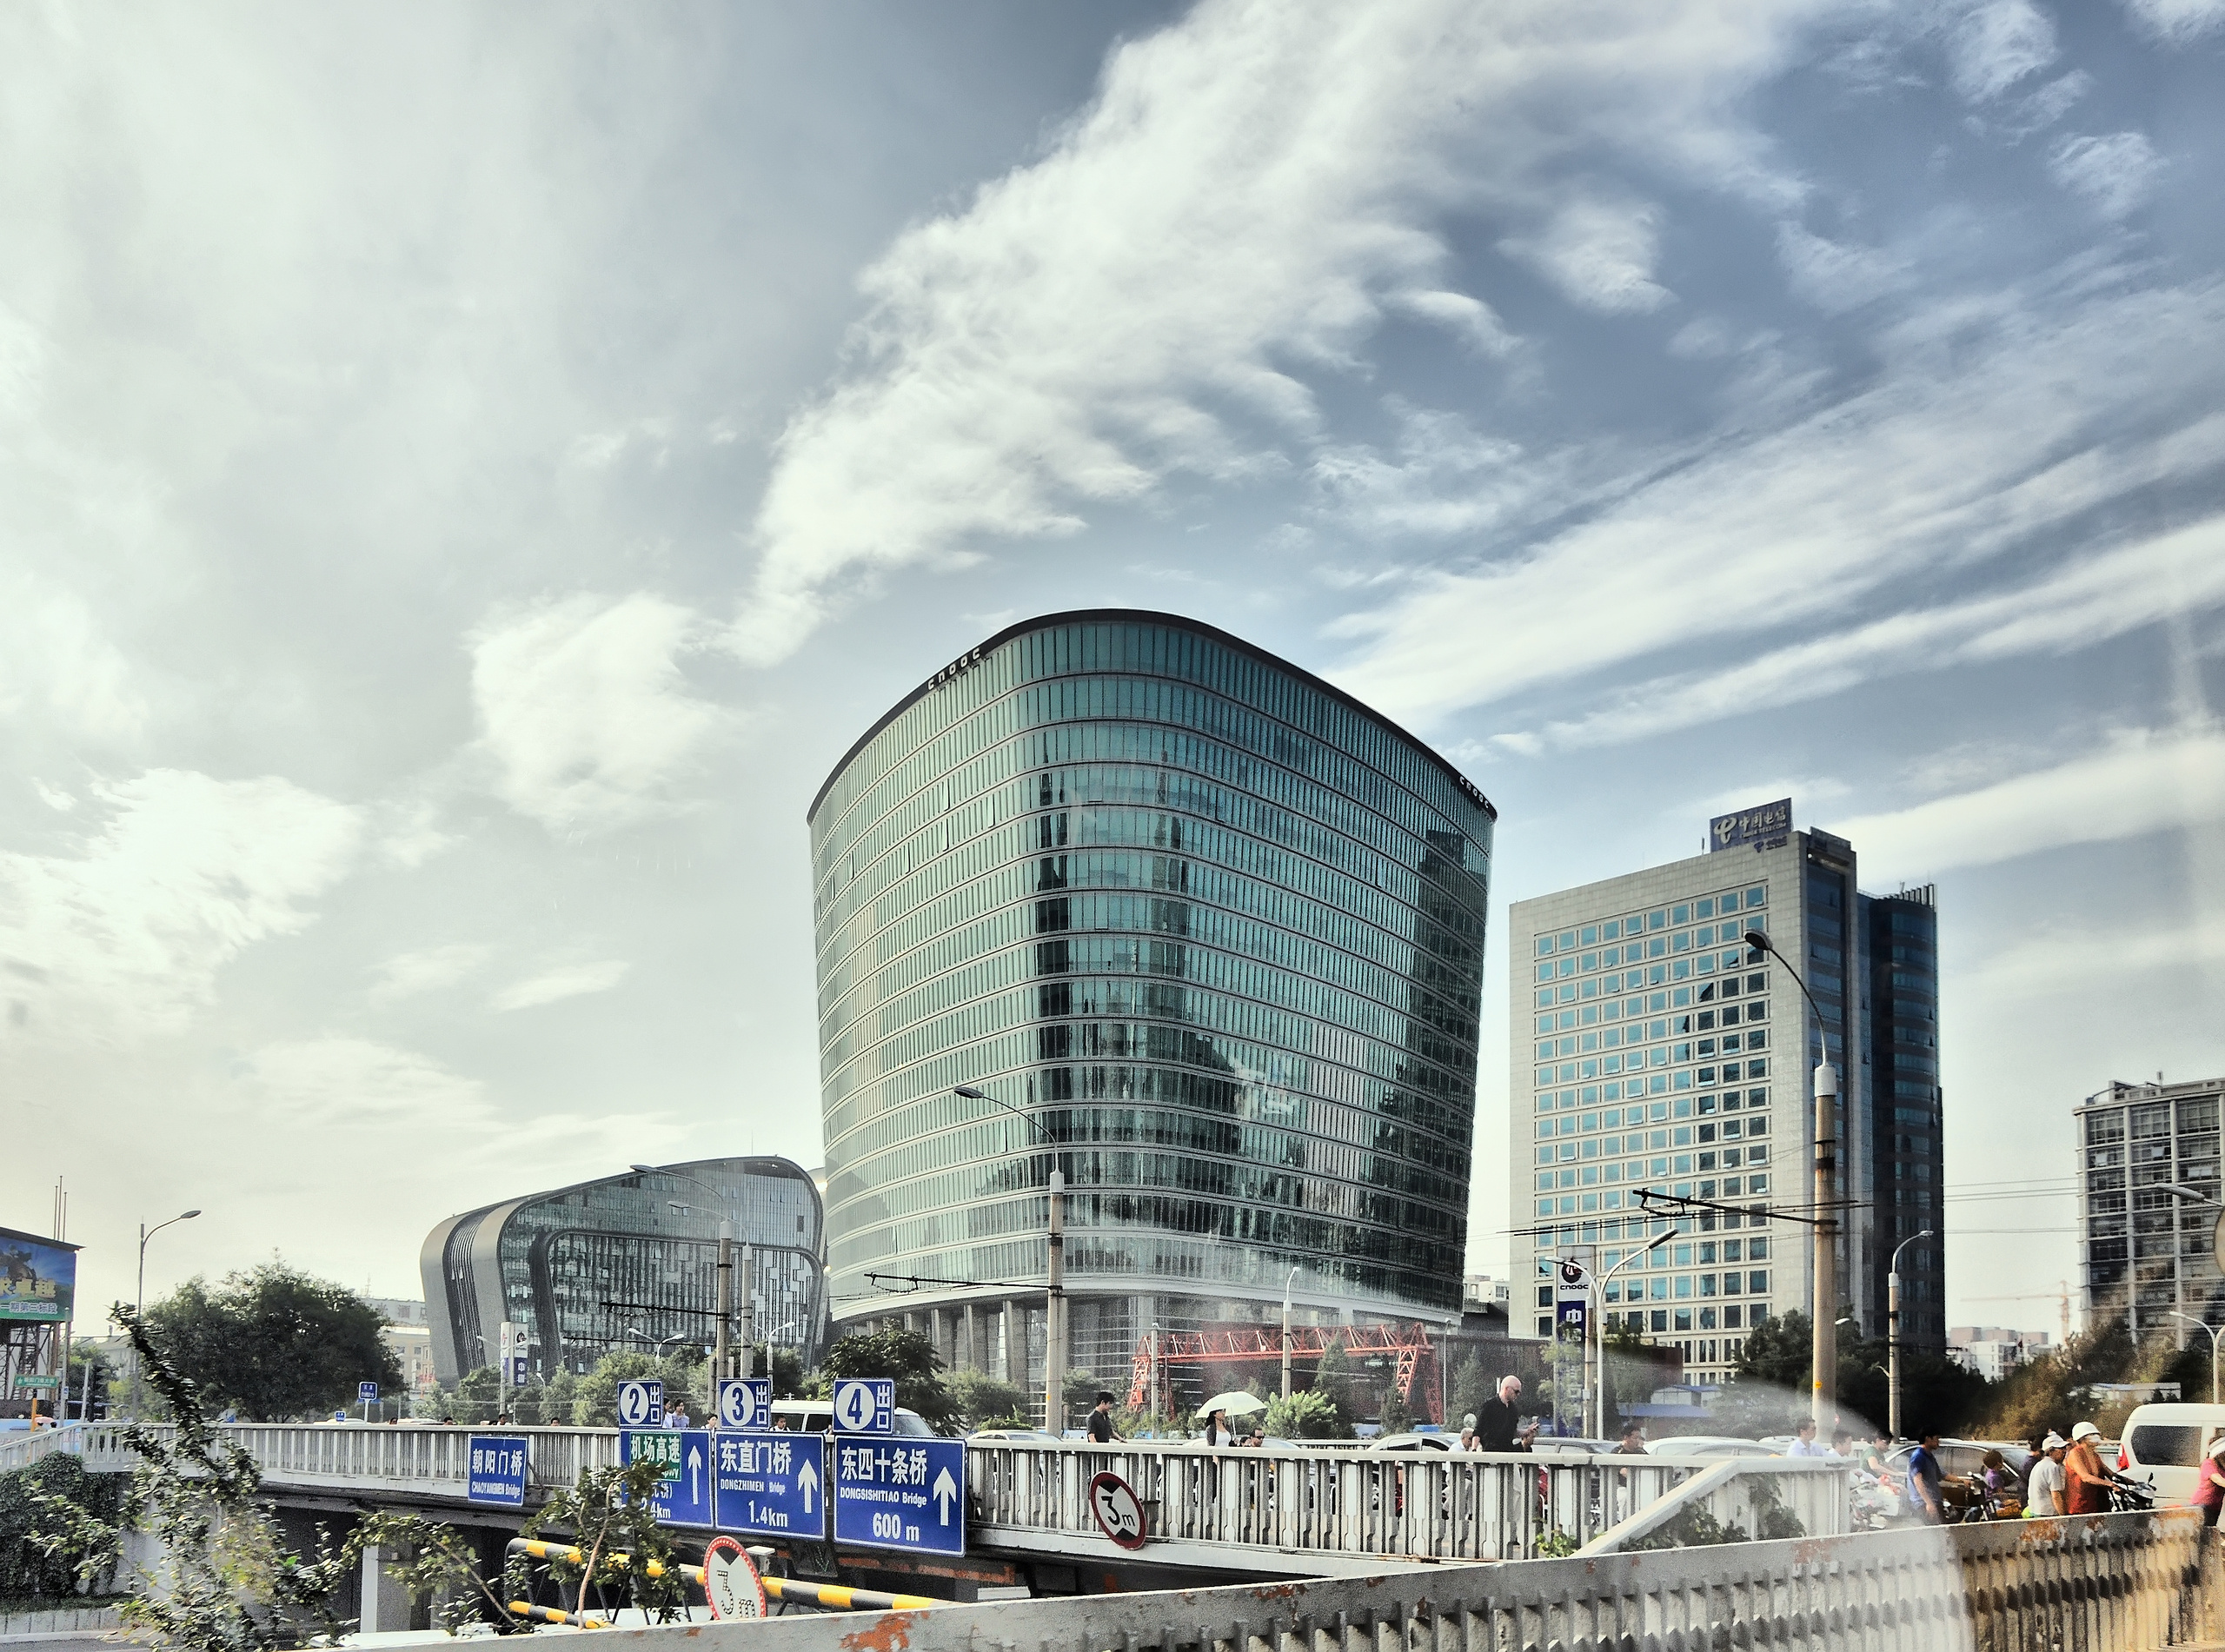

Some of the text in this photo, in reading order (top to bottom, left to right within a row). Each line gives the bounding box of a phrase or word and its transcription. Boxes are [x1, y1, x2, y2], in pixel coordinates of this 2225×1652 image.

[1739, 806, 1787, 833] 中国电信
[628, 1388, 641, 1420] 2
[650, 1385, 661, 1423] 出口
[732, 1387, 745, 1421] 3
[755, 1384, 767, 1425] 出口
[847, 1388, 863, 1424] 4
[876, 1384, 890, 1429] 出口
[472, 1448, 522, 1476] 朝阳门桥
[630, 1435, 681, 1463] 机场高速
[721, 1440, 792, 1475] 东直门桥
[841, 1446, 927, 1486] 东四十条桥
[505, 1483, 521, 1499] Bridge
[720, 1478, 786, 1496] DONGZHIMEN Bridge
[840, 1486, 927, 1509] DONGSISHITIAO Bridge
[748, 1499, 787, 1528] 1.4km
[872, 1512, 920, 1543] 600 m
